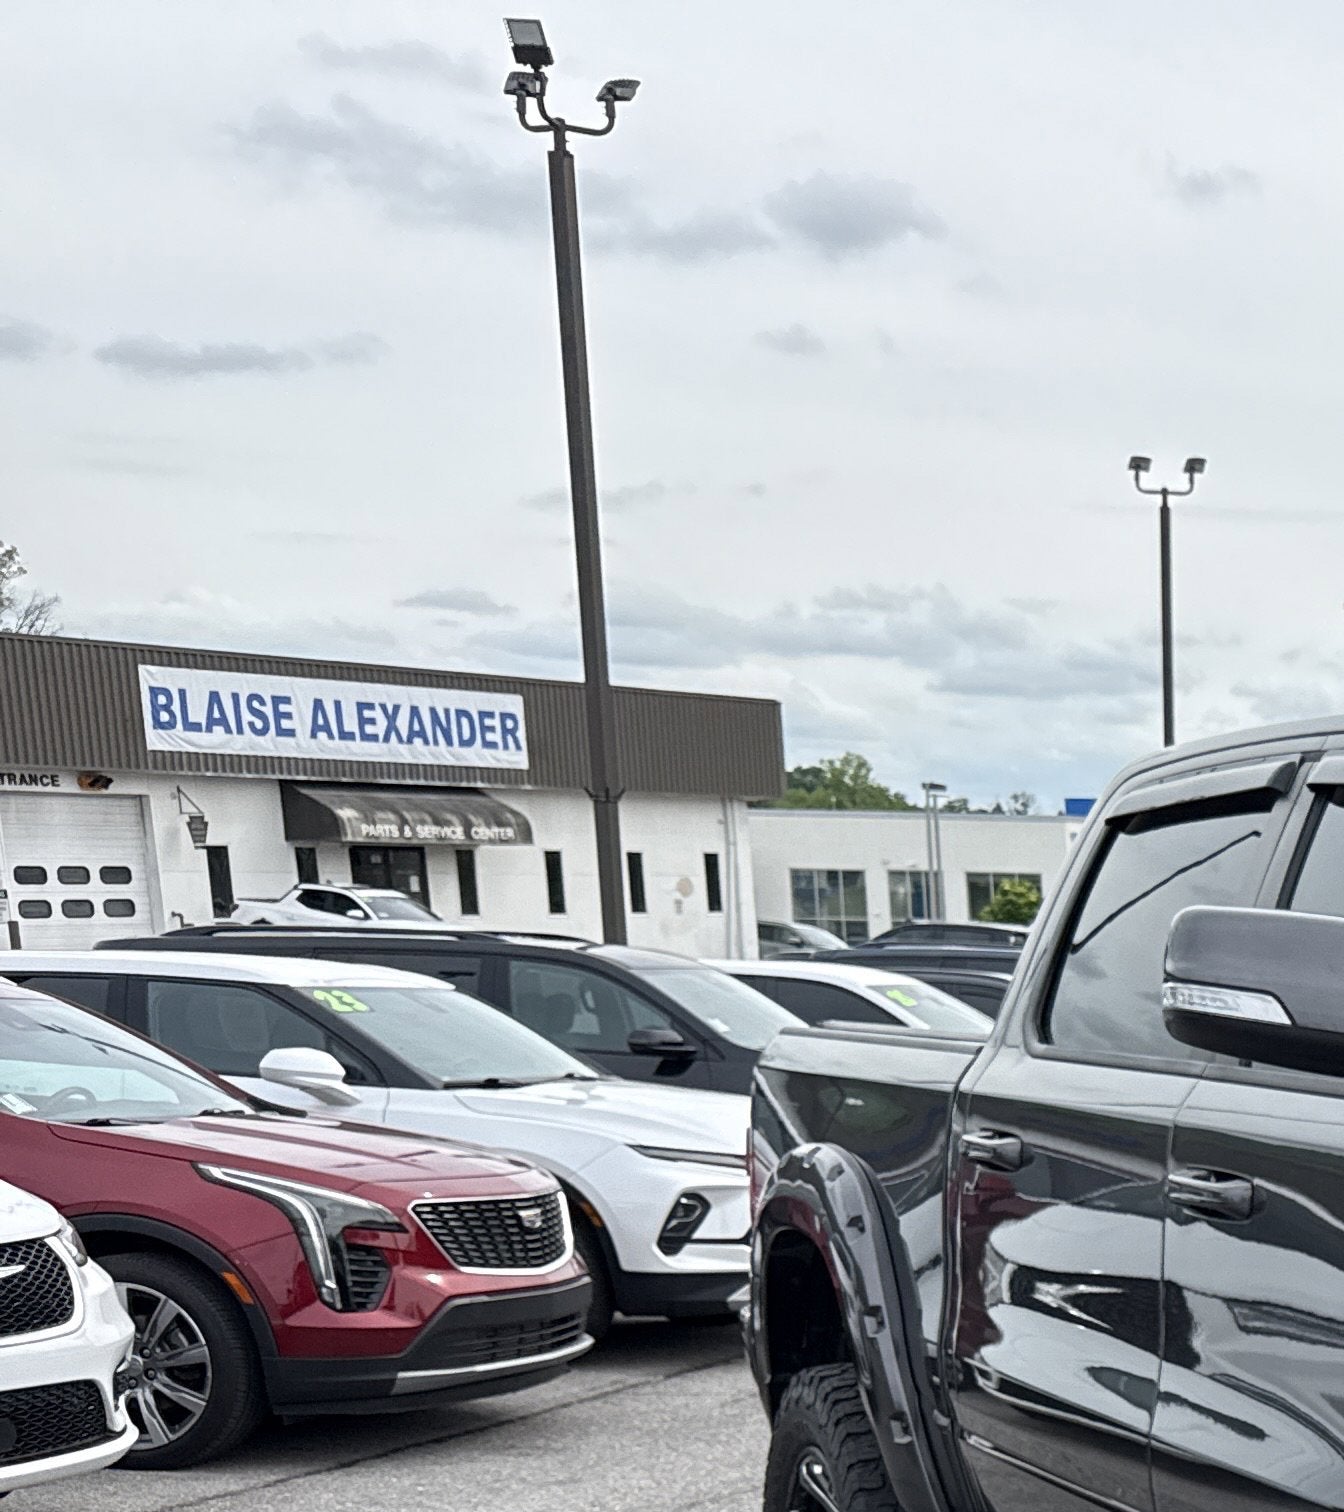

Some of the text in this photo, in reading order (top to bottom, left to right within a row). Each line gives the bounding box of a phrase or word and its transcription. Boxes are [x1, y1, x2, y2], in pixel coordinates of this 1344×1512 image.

[148, 686, 522, 751] BLAISE ALEXANDER
[360, 823, 515, 840] PARTS & SERVICE CENTER
